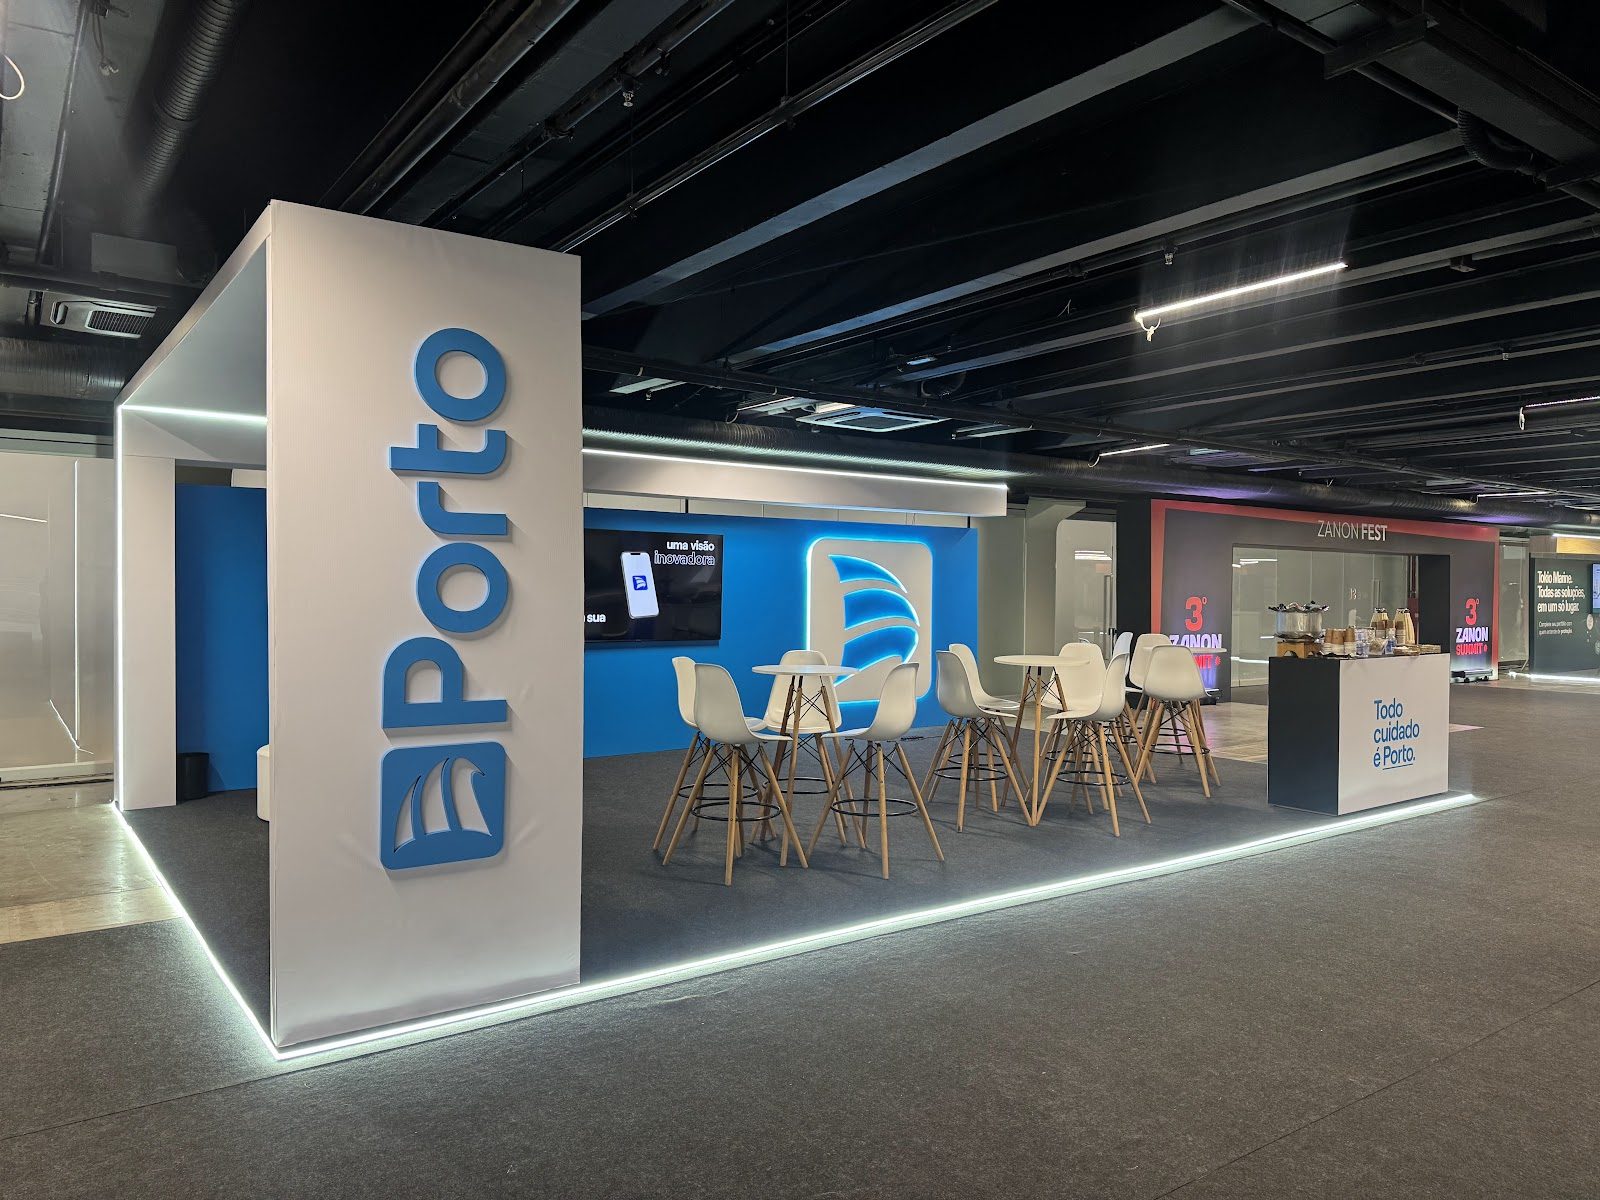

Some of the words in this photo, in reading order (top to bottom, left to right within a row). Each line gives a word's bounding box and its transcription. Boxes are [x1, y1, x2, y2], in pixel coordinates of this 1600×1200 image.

[381, 328, 509, 729] Porto
[1317, 520, 1359, 539] ZANON
[1361, 523, 1388, 541] FEST
[666, 541, 689, 551] uma
[690, 540, 715, 551] visão
[654, 550, 716, 565] inovadora
[1537, 570, 1552, 583] Tokio
[1537, 585, 1554, 598] Todas
[1554, 588, 1561, 598] as
[1537, 602, 1547, 612] em
[1547, 602, 1557, 612] um
[1558, 599, 1565, 612] só
[586, 613, 607, 623] sua
[1456, 626, 1489, 643] ZANON
[1456, 643, 1484, 656] SUMMIT
[1373, 697, 1403, 720] Todo
[1373, 718, 1420, 743] cuidado
[1373, 746, 1381, 767] é
[1383, 744, 1416, 766] Porto.
